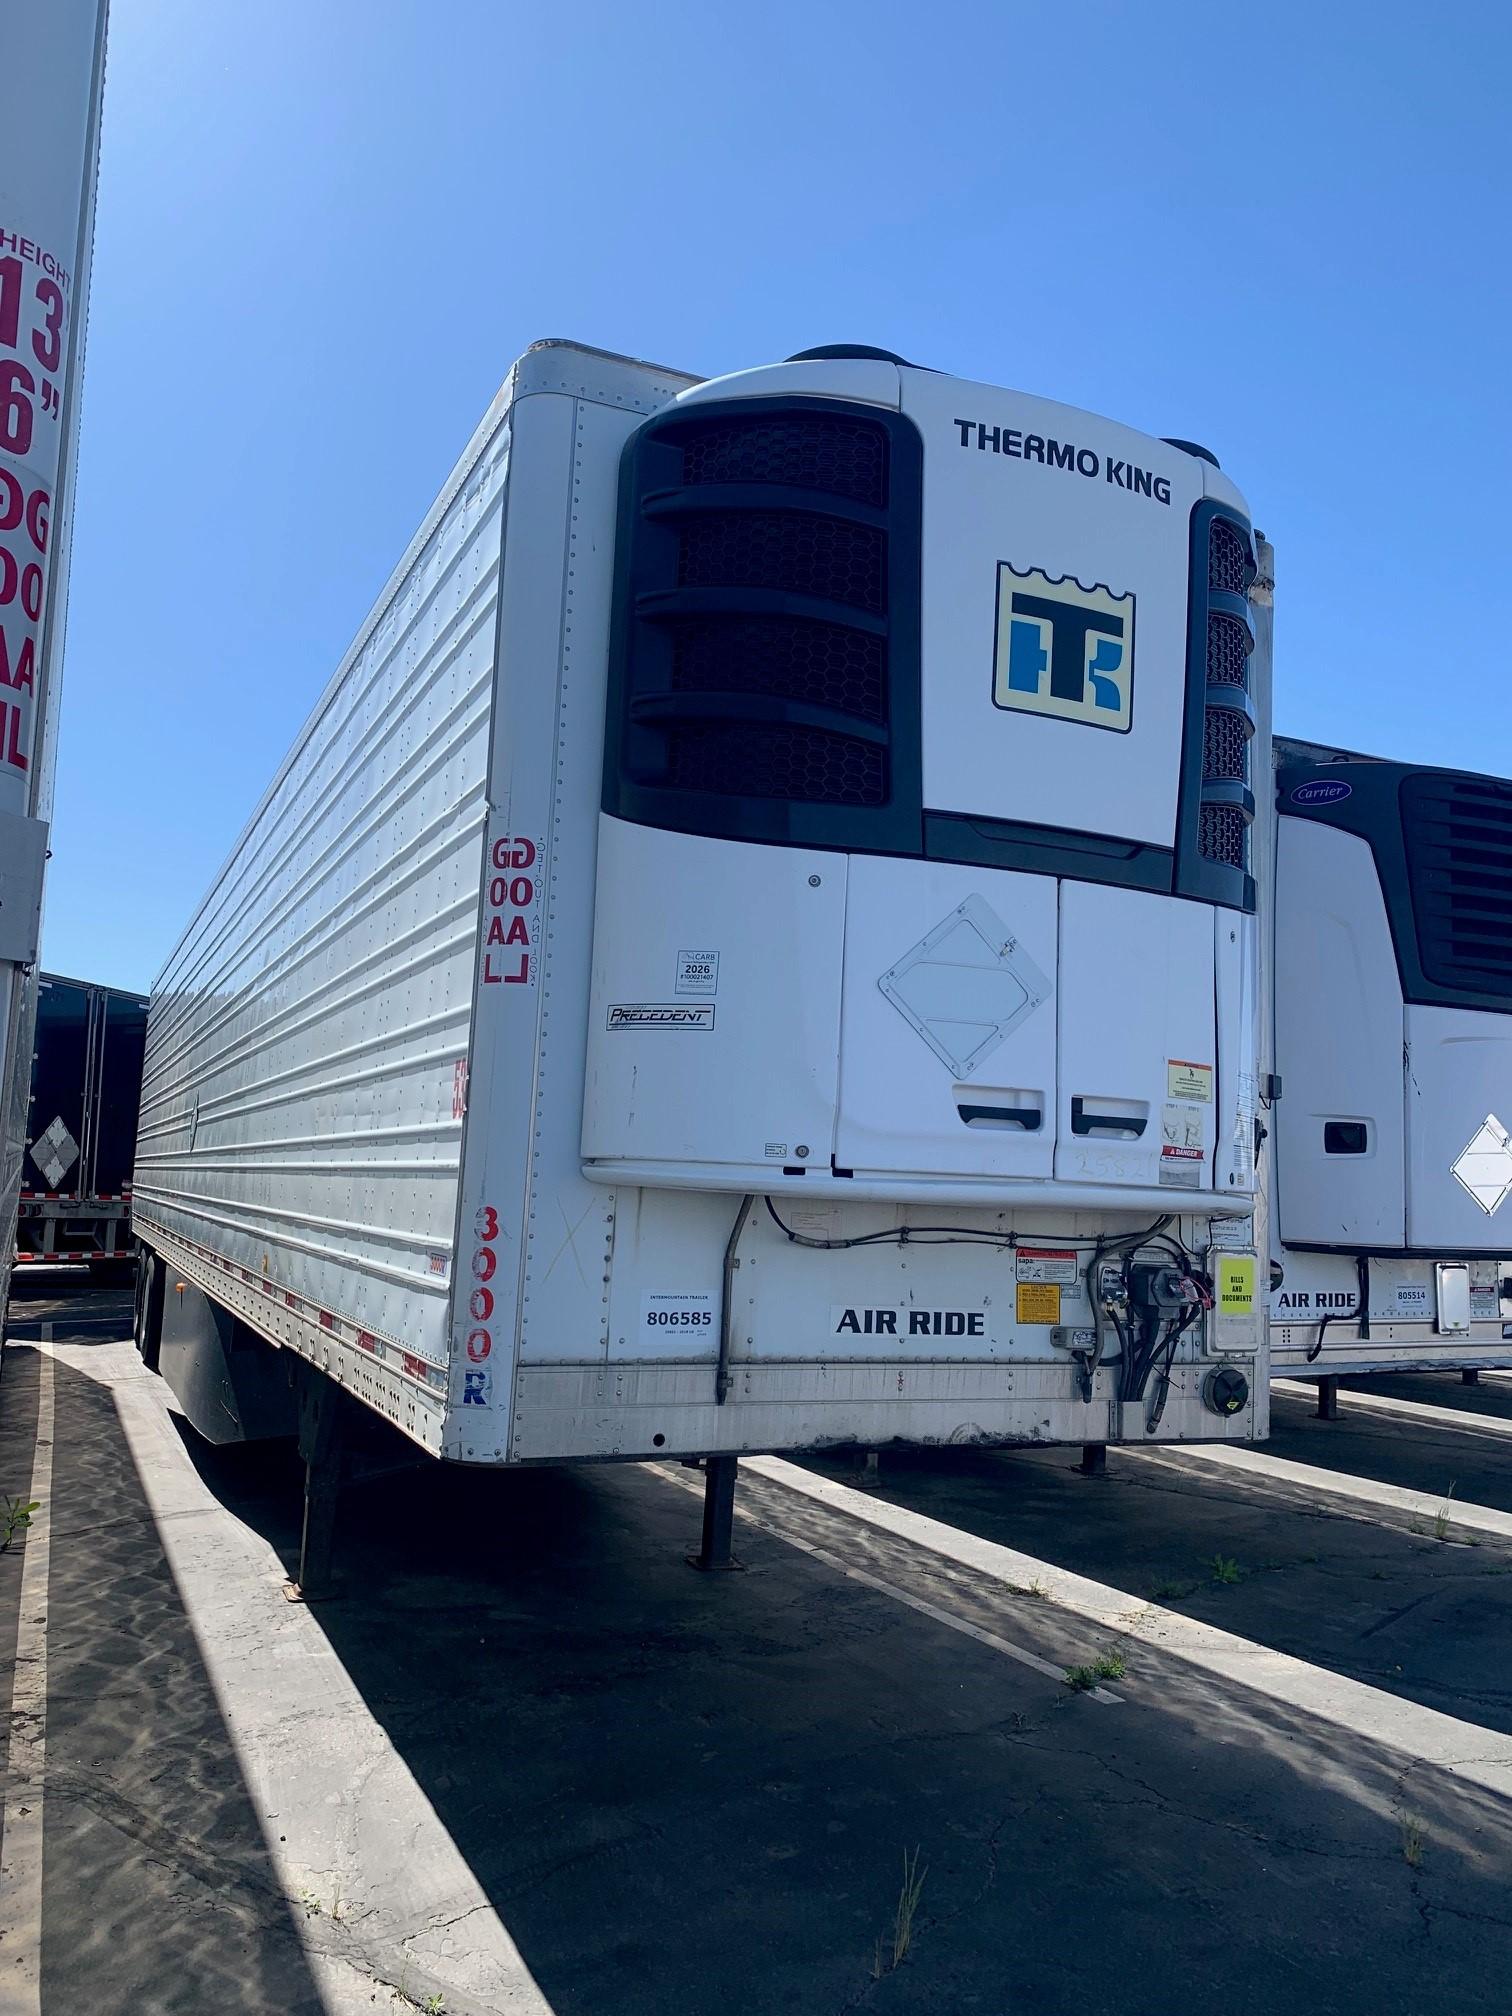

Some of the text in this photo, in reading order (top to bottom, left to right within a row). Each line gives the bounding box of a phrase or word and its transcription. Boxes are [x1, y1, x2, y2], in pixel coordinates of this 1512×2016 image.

[0, 228, 71, 294] HEIGHT
[953, 418, 1171, 506] THERMO KING
[1297, 786, 1344, 800] Carrier
[695, 953, 715, 961] CARB
[685, 965, 710, 974] 2026
[610, 1008, 711, 1022] PRECEDENT
[1175, 1149, 1198, 1157] DANGER
[1230, 1276, 1244, 1284] BILLS
[1232, 1285, 1242, 1293] AND
[1222, 1294, 1252, 1303] DOCUMENTS
[1278, 1292, 1356, 1308] AIR RIDE
[1398, 1291, 1426, 1300] 805514
[646, 1312, 712, 1326] 806585
[836, 1309, 985, 1337] AIR RIDE
